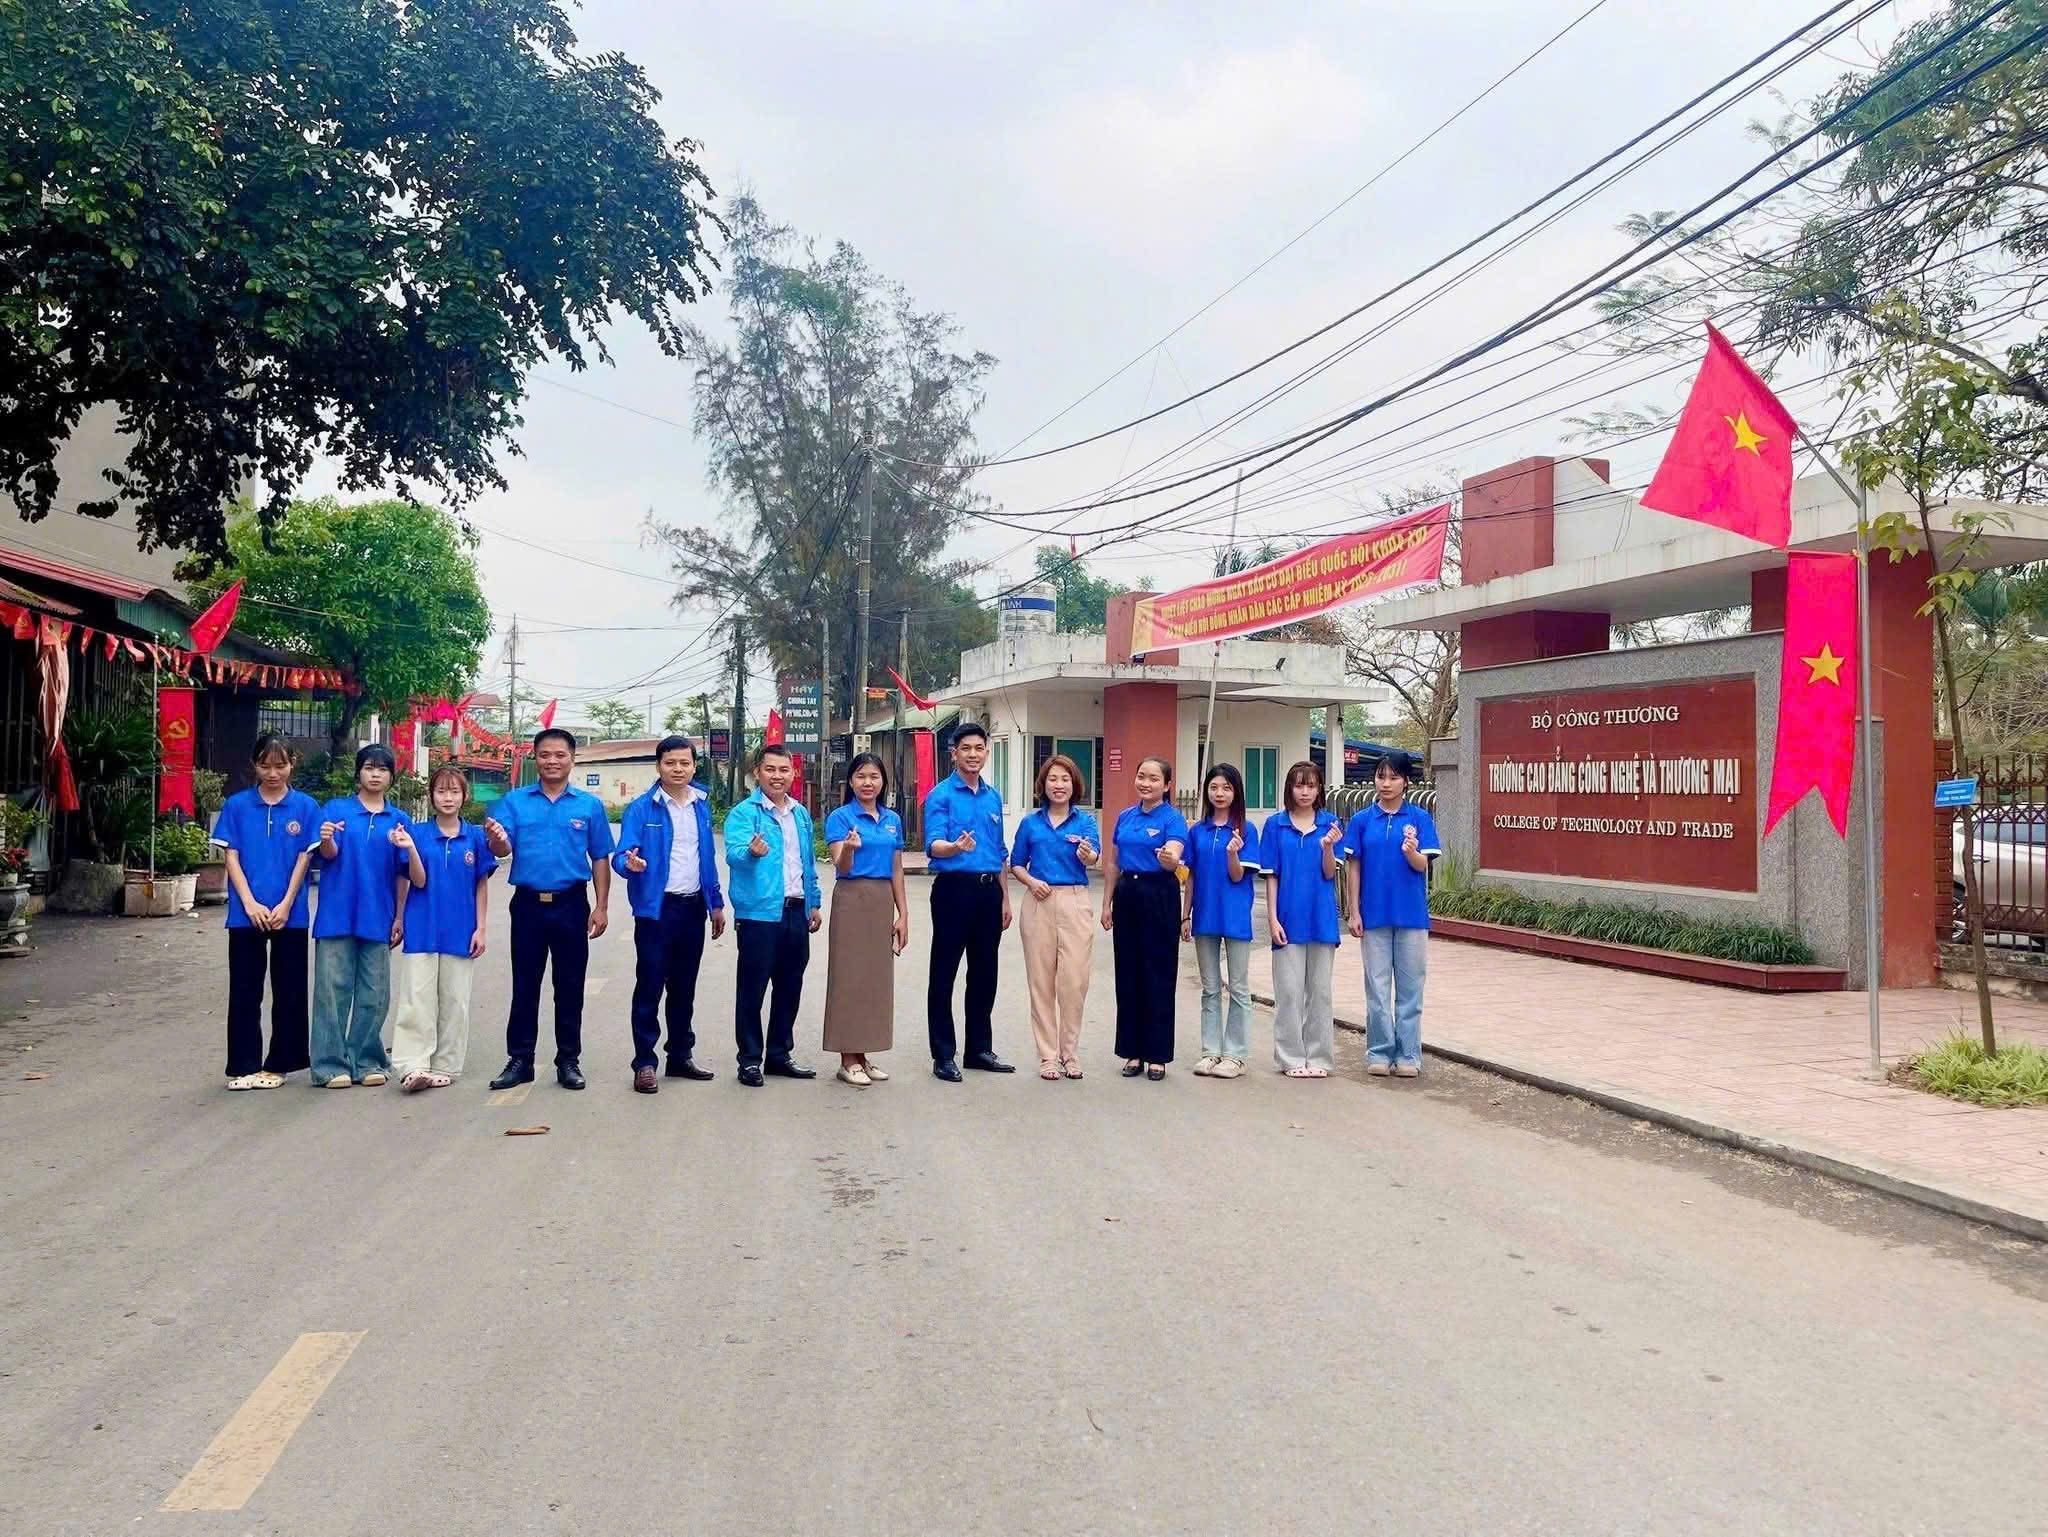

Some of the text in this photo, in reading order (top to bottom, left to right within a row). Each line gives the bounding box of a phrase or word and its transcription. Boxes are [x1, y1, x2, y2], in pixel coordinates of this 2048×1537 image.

[1320, 545, 1347, 576] QUỐC
[1350, 543, 1369, 567] HỘI
[1266, 594, 1284, 617] CÁC
[1531, 705, 1680, 733] BỘ CÔNG THƯƠNG
[1488, 745, 1740, 803] TRƯỜNG CAO ĐẲNG CÔNG NGHỆ VÀ THƯƠNG MẠI
[1494, 814, 1735, 839] COLLEGE OF TECHNOLOGY AND TRADE
